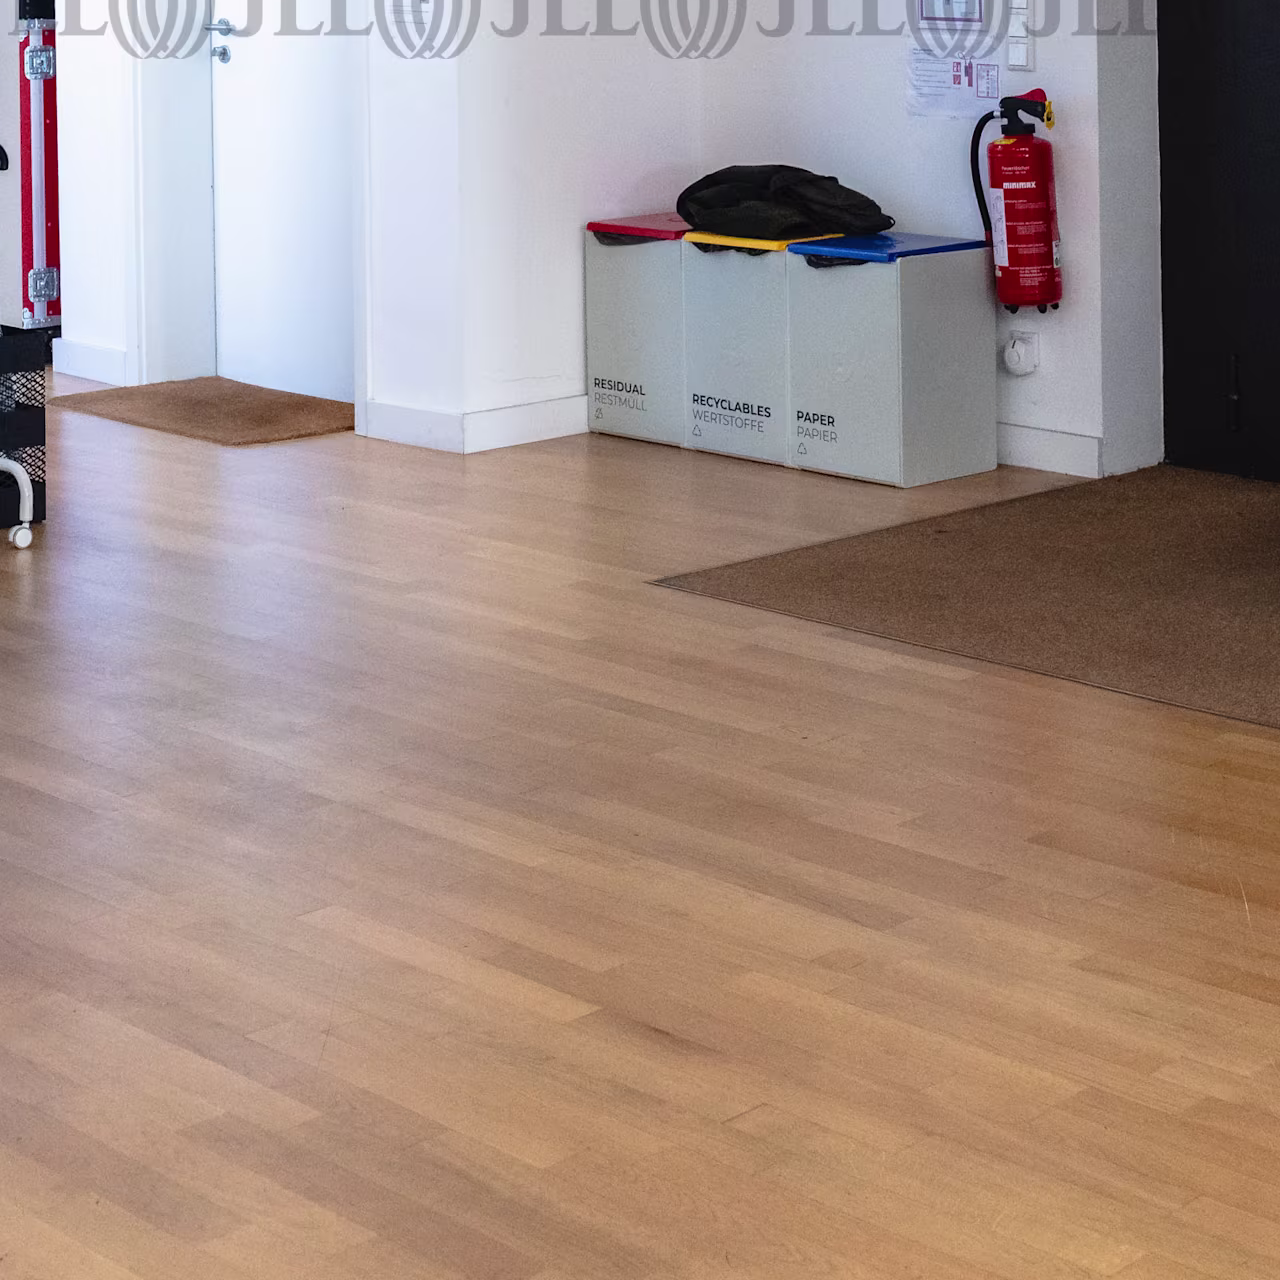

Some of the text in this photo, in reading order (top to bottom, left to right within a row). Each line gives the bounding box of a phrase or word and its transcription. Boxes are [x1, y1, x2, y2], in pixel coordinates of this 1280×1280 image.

[1003, 181, 1036, 189] minimax
[594, 377, 646, 396] RESIDUAL
[594, 391, 648, 412] RESTMÜLL
[692, 393, 771, 418] RECYCLABLES
[692, 408, 764, 433] WERTSTOFFE
[796, 410, 835, 427] PAPER
[797, 425, 838, 443] PAPIER
